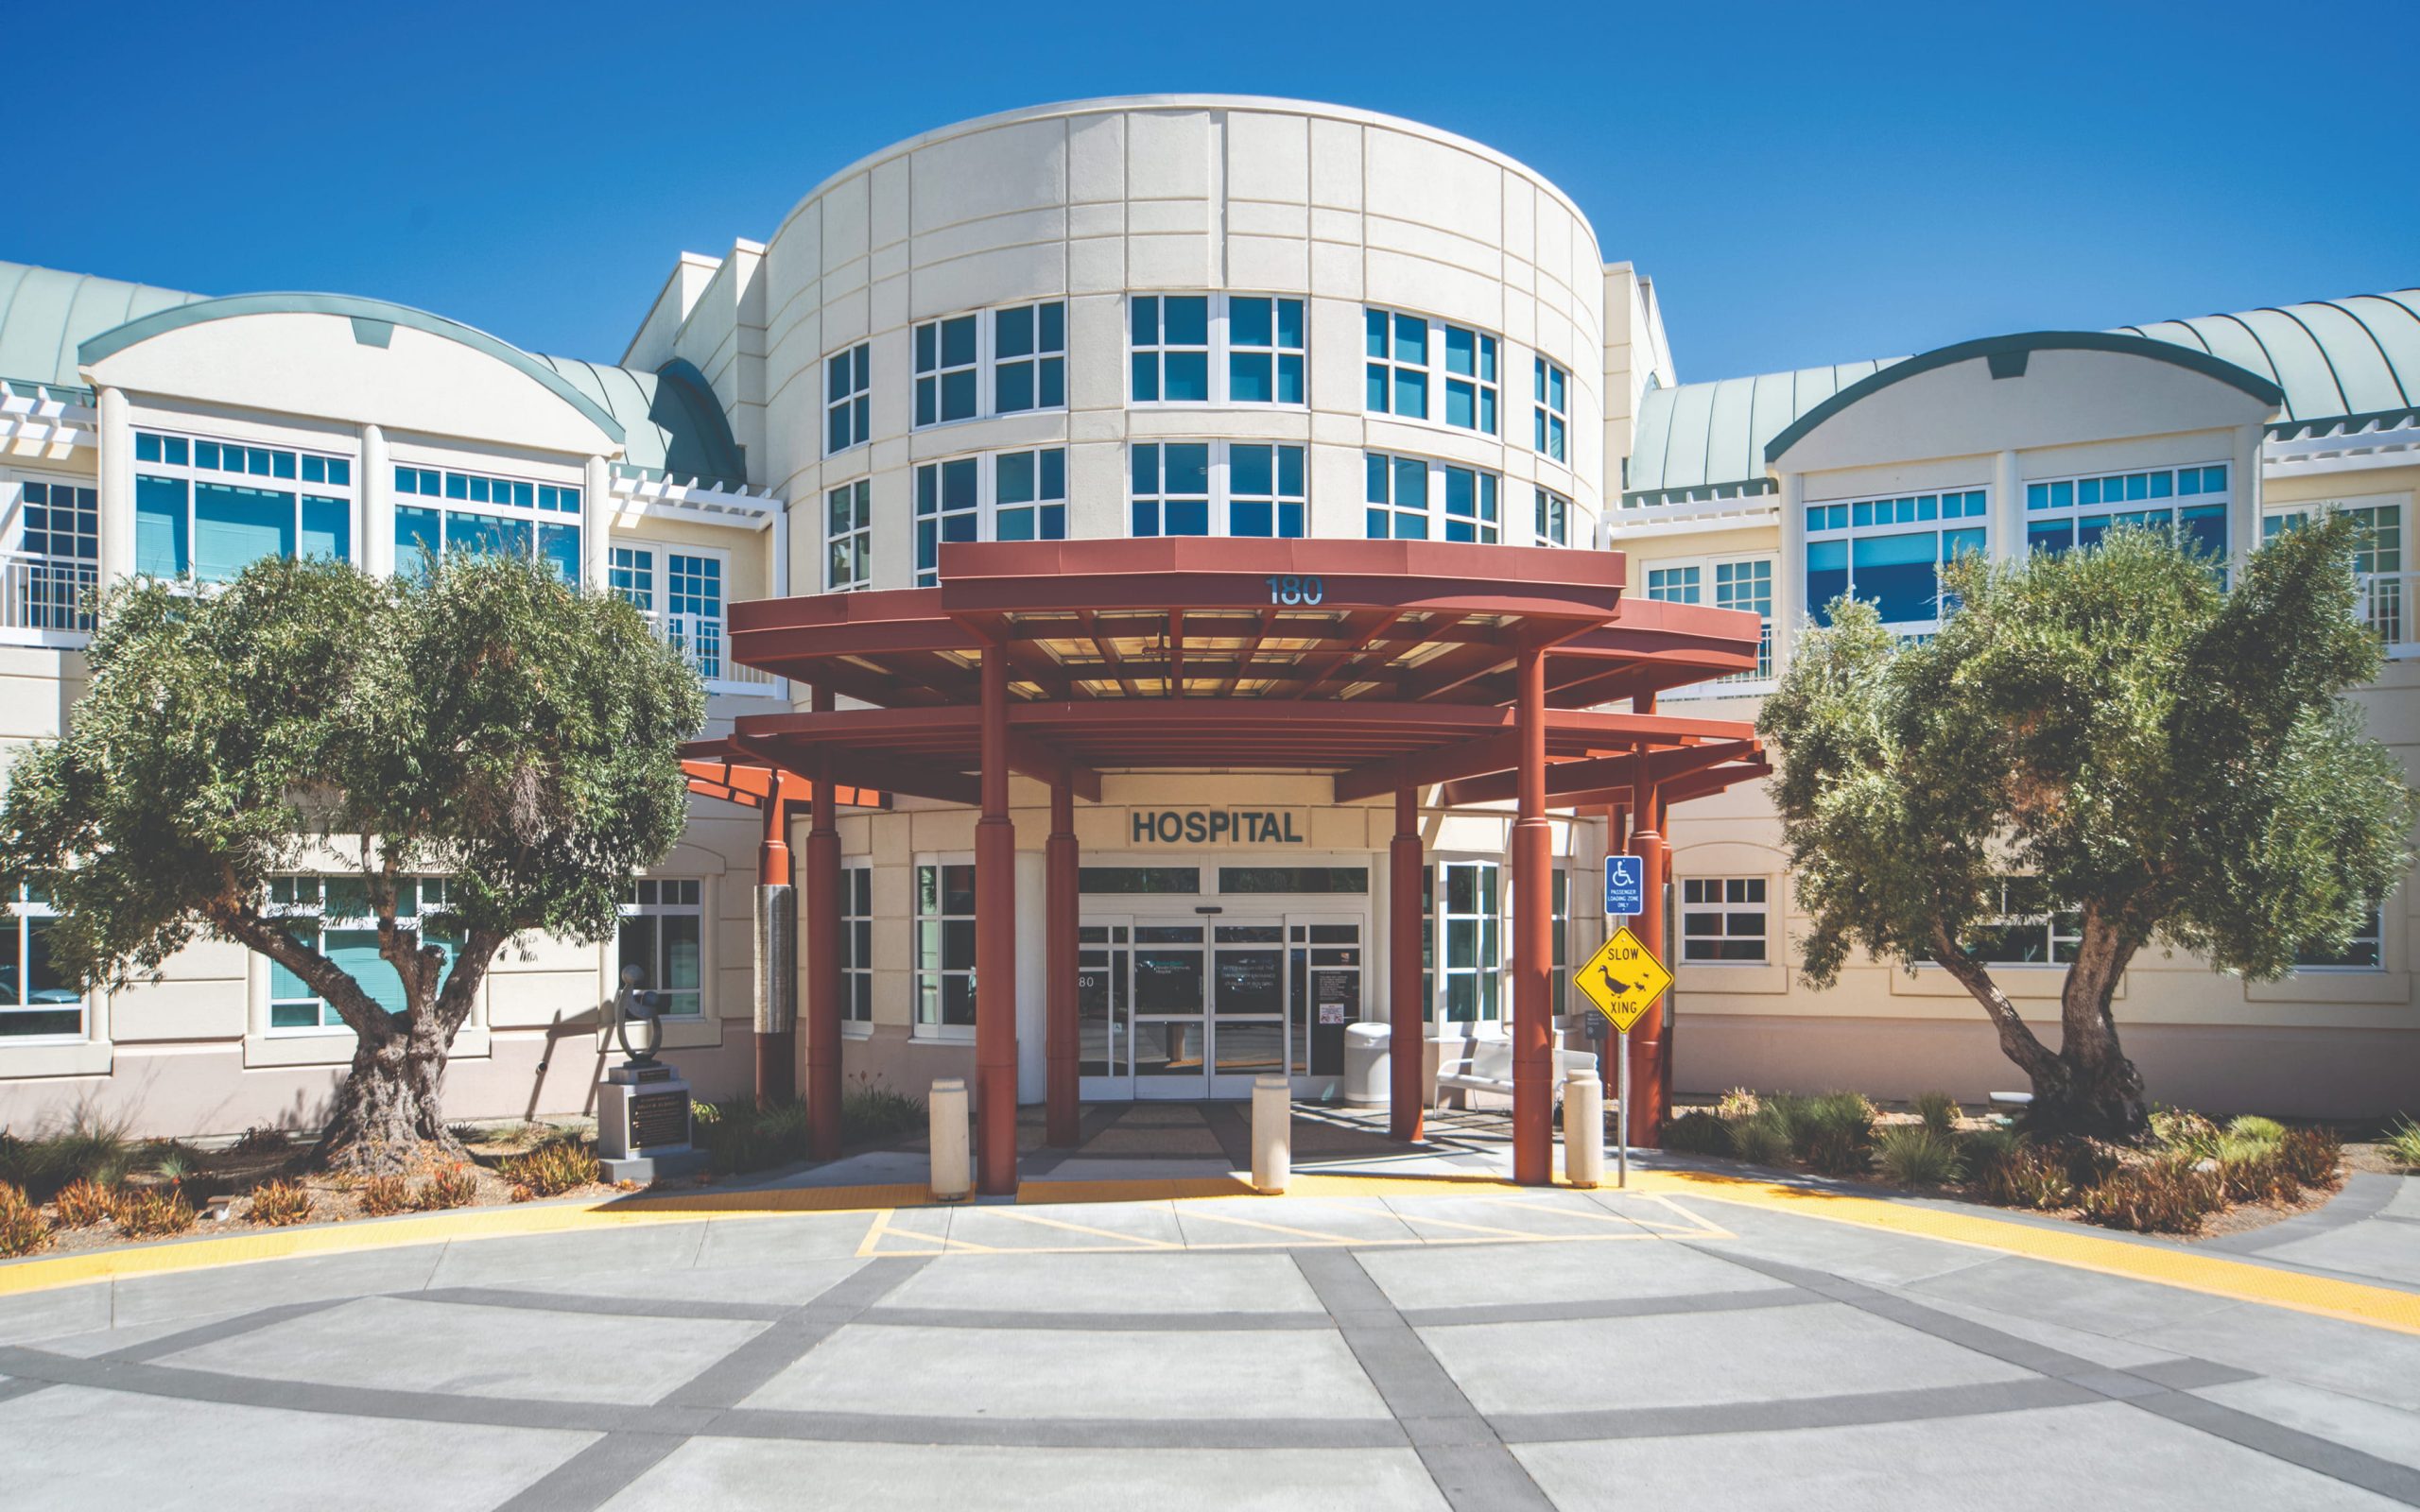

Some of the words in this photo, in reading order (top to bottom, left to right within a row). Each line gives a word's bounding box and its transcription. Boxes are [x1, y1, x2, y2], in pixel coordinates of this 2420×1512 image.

[1265, 575, 1323, 606] 180
[1132, 811, 1304, 843] HOSPITAL
[1607, 948, 1639, 961] SLOW
[1079, 976, 1094, 988] 80
[1610, 1001, 1637, 1014] XING
